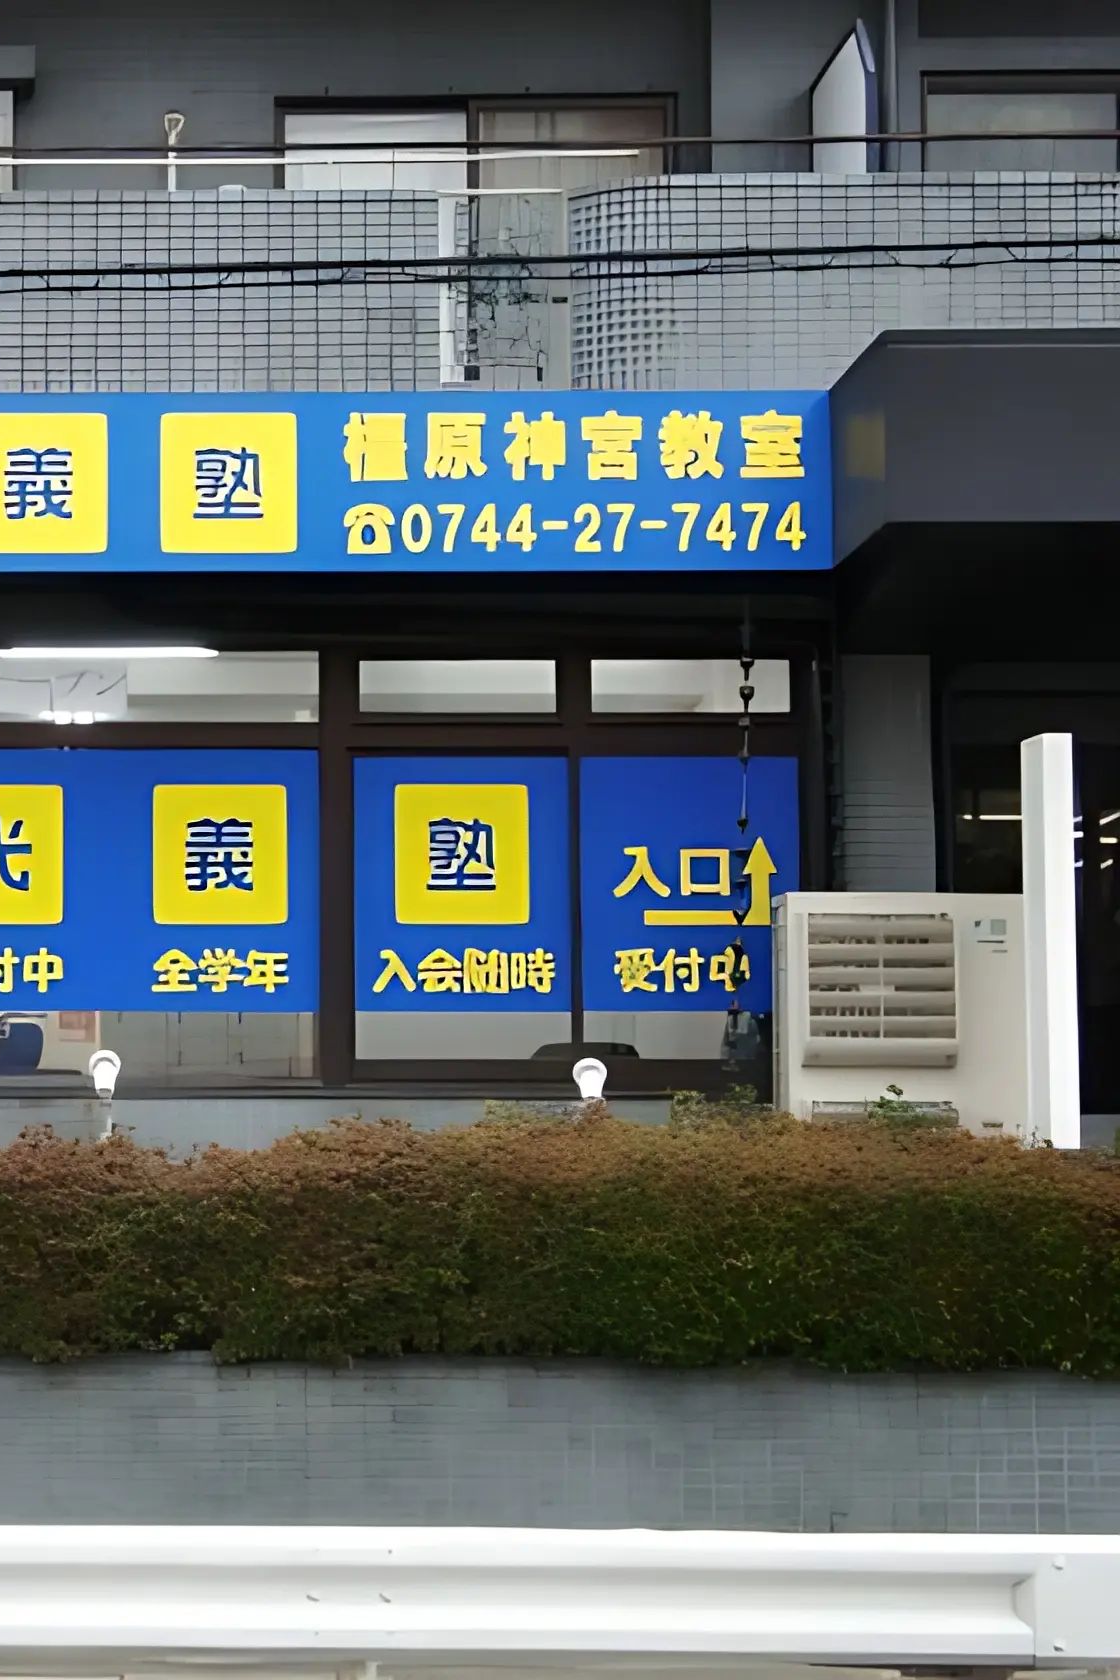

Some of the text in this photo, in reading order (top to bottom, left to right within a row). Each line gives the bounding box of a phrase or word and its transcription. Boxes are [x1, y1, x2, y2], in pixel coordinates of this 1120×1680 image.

[401, 502, 806, 554] 0744-27-7474
[613, 846, 731, 898] 入口
[151, 948, 290, 993] 全学年
[372, 948, 556, 993] 入会随時
